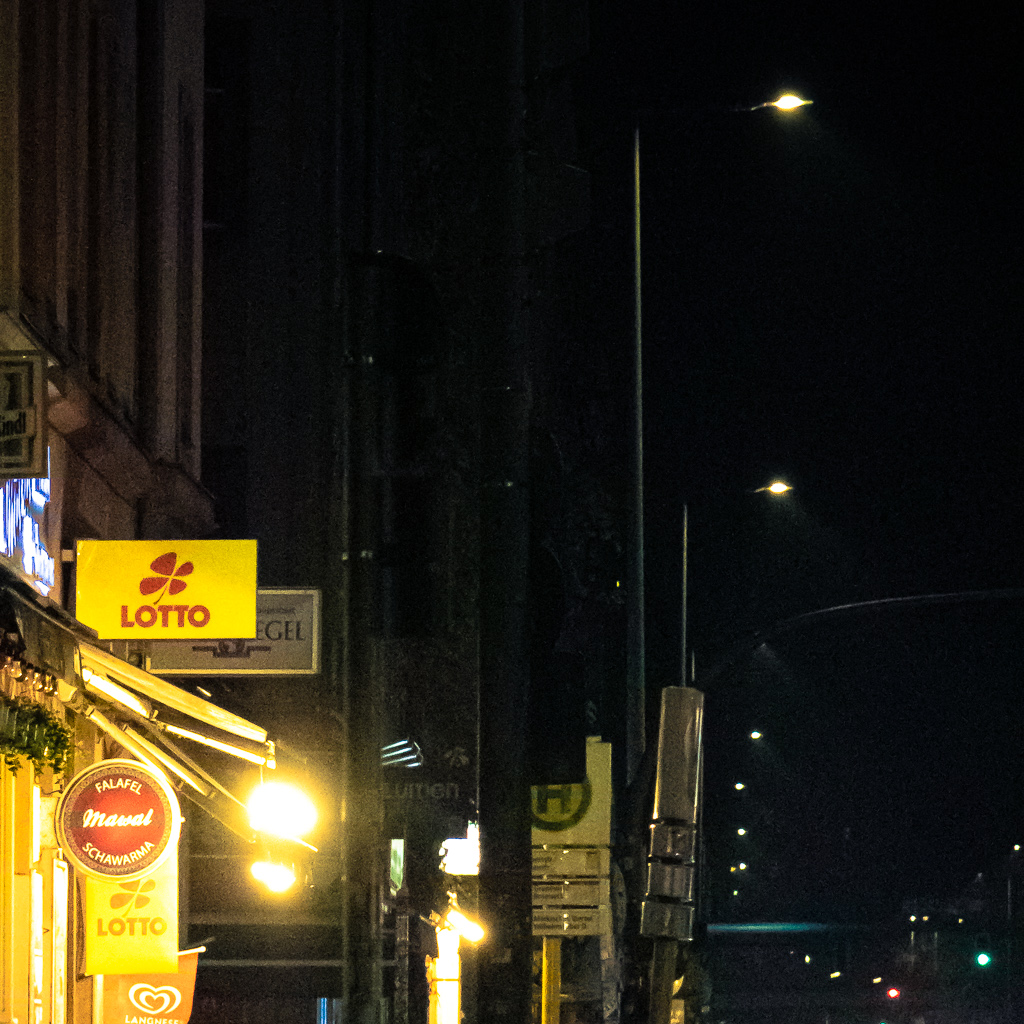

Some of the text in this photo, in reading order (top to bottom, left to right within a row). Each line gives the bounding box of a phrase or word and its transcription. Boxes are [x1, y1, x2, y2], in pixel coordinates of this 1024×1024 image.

[121, 604, 211, 628] LOTTO
[95, 778, 143, 796] FALAFEL
[82, 808, 154, 828] Mawal
[82, 841, 155, 866] SCHAWARMA
[96, 917, 168, 937] LOTTO
